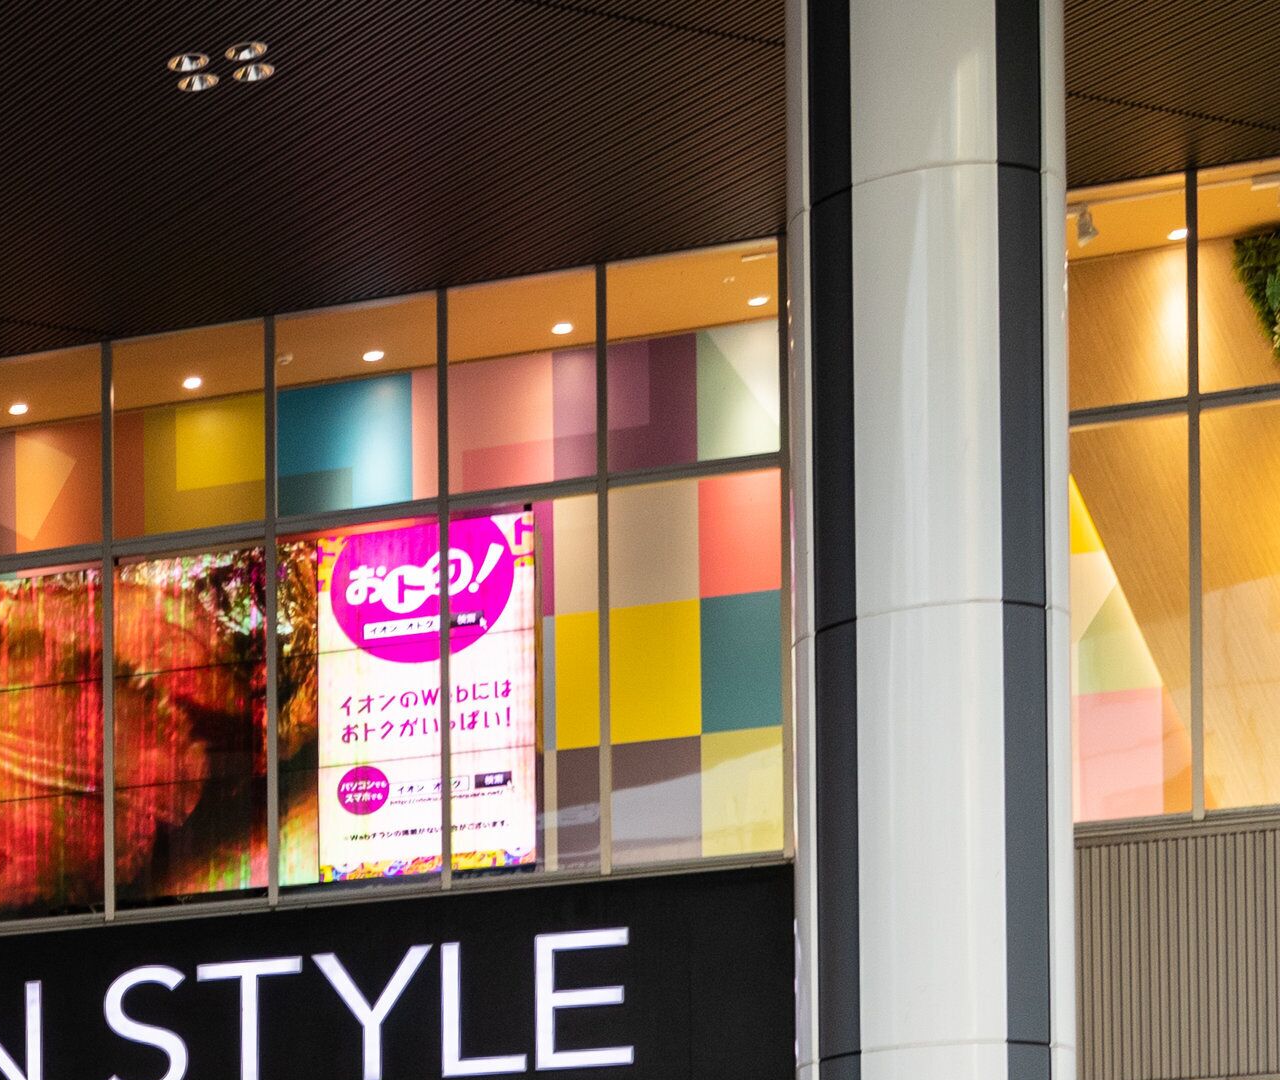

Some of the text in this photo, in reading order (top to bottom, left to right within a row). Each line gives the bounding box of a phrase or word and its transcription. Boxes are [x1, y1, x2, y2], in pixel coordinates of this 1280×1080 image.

[340, 679, 512, 717] イオンのWbには
